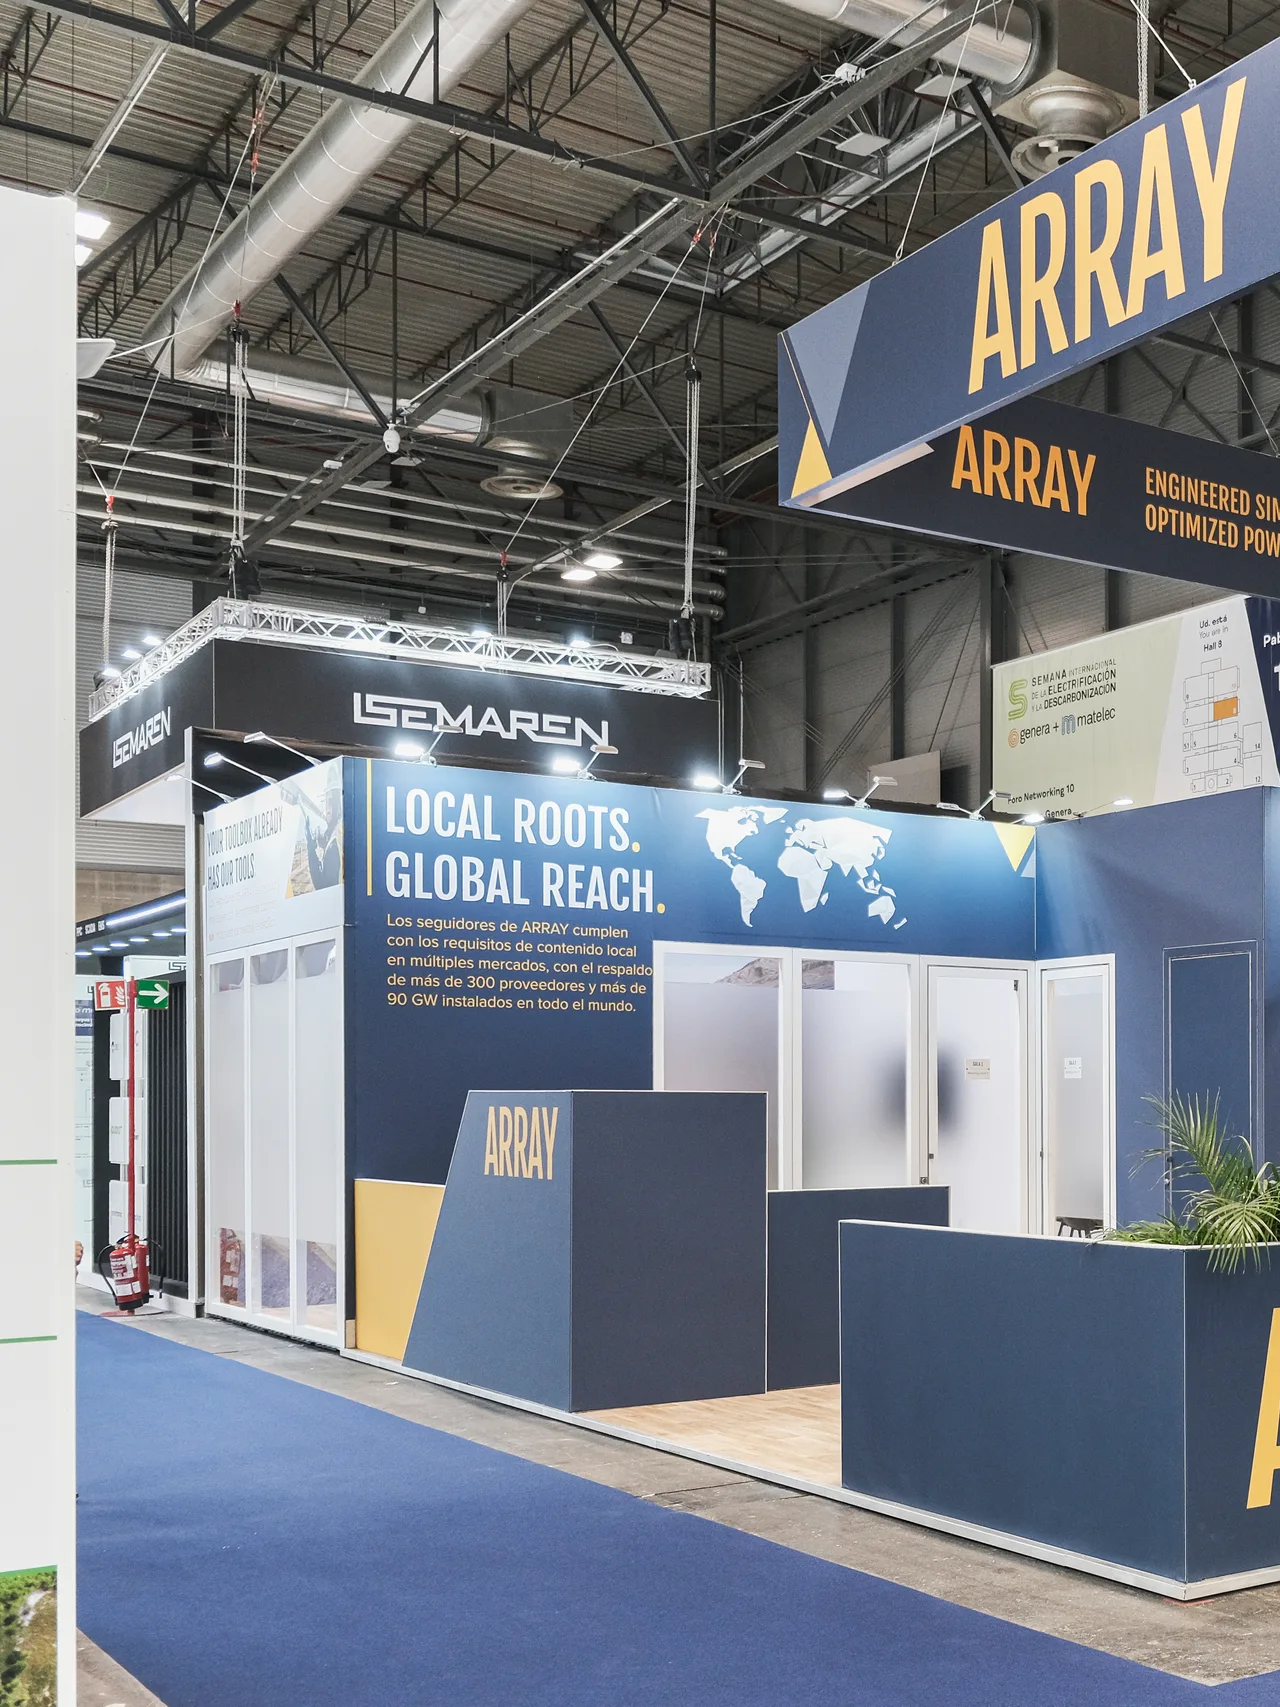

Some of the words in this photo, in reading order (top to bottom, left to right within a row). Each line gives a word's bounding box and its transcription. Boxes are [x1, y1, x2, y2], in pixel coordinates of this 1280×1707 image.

[968, 77, 1246, 394] ARRAY
[951, 425, 1096, 516] ARRAY
[1145, 466, 1250, 516] ENGINEERED
[1145, 503, 1239, 549] OPTIMIZED
[1199, 620, 1210, 629] Ud.
[1211, 615, 1228, 626] está
[1199, 631, 1210, 639] You
[1203, 642, 1217, 652] Hall
[1031, 669, 1067, 687] SEMANA
[1069, 658, 1117, 678] INTERNACIONAL
[1031, 691, 1038, 700] DE
[1040, 688, 1047, 698] LA
[1048, 668, 1117, 696] ELECTRIFICACIÓN
[1036, 703, 1043, 712] LA
[1044, 681, 1117, 710] DESCARBONIZACIÓN
[1019, 723, 1051, 745] genera
[1077, 706, 1116, 727] matelec
[1023, 786, 1065, 802] Networking
[1066, 783, 1075, 793] 10
[386, 785, 501, 841] LOCAL
[514, 798, 641, 853] ROOTS.
[1045, 808, 1072, 818] Genera
[206, 829, 224, 857] YOUR
[224, 817, 253, 851] TOOLBOX
[253, 805, 283, 840] ALREADY
[207, 862, 220, 891] HAS
[220, 859, 234, 887] OUR
[234, 853, 256, 883] TOOLS
[385, 850, 530, 906] GLOBAL
[542, 861, 666, 914] REACH.
[387, 913, 413, 928] Los
[416, 916, 496, 933] seguidores
[499, 920, 518, 933] de
[521, 921, 569, 935] ARRAY
[572, 924, 629, 940] cumplen
[387, 936, 414, 948] con
[418, 935, 439, 949] los
[443, 936, 512, 953] requisitos
[515, 940, 533, 953] de
[536, 942, 604, 957] contenido
[607, 945, 637, 958] local
[387, 955, 406, 966] en
[410, 953, 475, 971] múltiples
[478, 957, 550, 974] mercados,
[553, 963, 578, 973] con
[581, 961, 594, 974] el
[597, 963, 653, 978] respaldo
[387, 973, 406, 986] de
[410, 974, 440, 988] más
[444, 975, 463, 988] de
[467, 975, 496, 989] 300
[499, 977, 585, 994] proveedores
[588, 983, 597, 995] y
[600, 980, 626, 994] más
[629, 982, 647, 995] de
[387, 993, 408, 1006] 90
[412, 993, 439, 1007] GW
[442, 994, 513, 1009] instalados
[516, 999, 534, 1010] en
[537, 998, 569, 1011] todo
[572, 999, 585, 1011] el
[588, 1000, 637, 1013] mundo.
[483, 1105, 559, 1180] ARRAY
